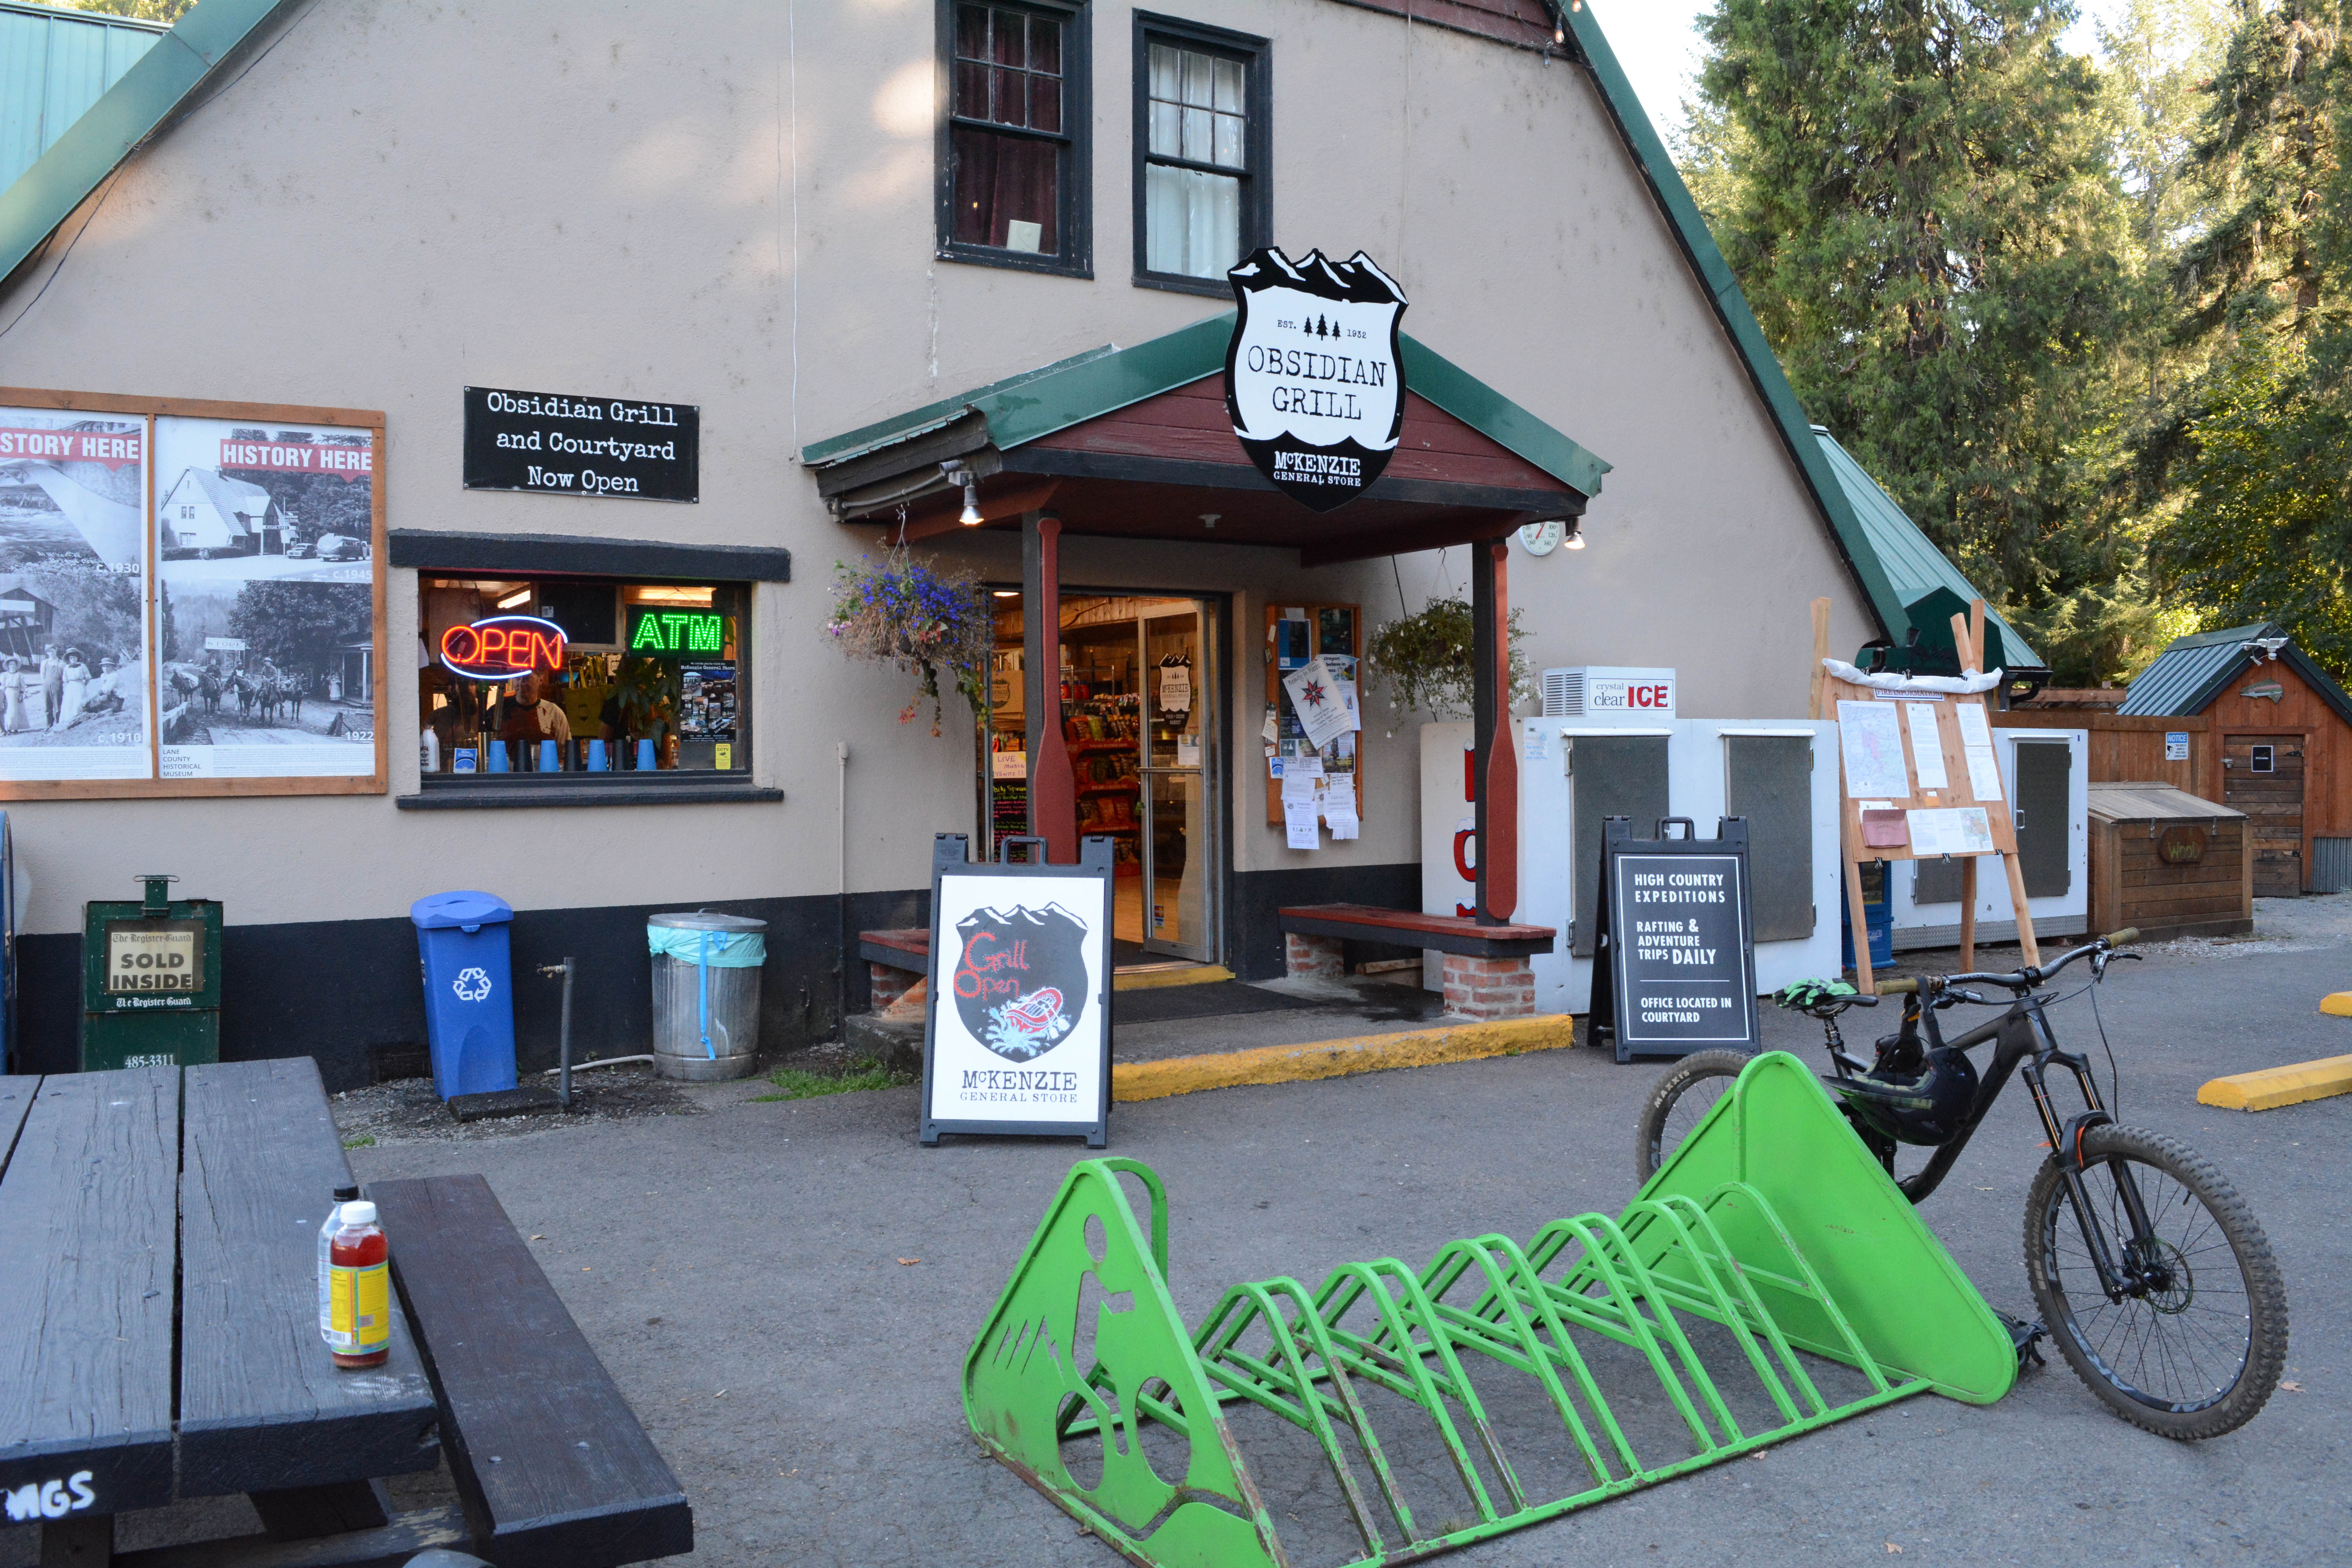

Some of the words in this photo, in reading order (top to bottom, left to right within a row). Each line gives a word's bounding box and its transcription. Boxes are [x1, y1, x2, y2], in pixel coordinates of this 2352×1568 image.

[1277, 319, 1296, 329] EST.
[1347, 329, 1367, 339] 1932
[1248, 345, 1387, 387] OBSIDIAN
[488, 392, 603, 420] Obsidian
[610, 403, 678, 426] Grill
[1272, 387, 1362, 420] GRILL
[82, 437, 139, 459] HERE
[497, 431, 542, 450] and
[550, 432, 675, 462] Courtyard
[223, 444, 313, 467] HISTORY
[320, 450, 372, 470] HERE
[528, 466, 575, 488] Now
[582, 470, 639, 494] Open
[1274, 472, 1325, 486] GENERAL
[1328, 476, 1361, 487] STORE
[96, 563, 140, 573] c.1930
[333, 570, 372, 579] c.1945
[633, 614, 721, 650] ATM
[441, 625, 561, 669] OPEN
[1288, 672, 1304, 685] Beauty
[1596, 683, 1624, 691] crystal
[1628, 682, 1668, 707] ICE
[1594, 692, 1625, 706] clear
[98, 733, 142, 743] c.1910
[345, 731, 374, 741] 1922
[1635, 874, 1664, 886] HIGH
[1669, 874, 1724, 886] COUNTRY
[1635, 891, 1725, 903] EXPEDITIONS
[1637, 922, 1683, 933] RAFTING
[1688, 918, 1699, 933] &
[113, 933, 129, 942] The
[1638, 936, 1700, 947] ADVENTURE
[964, 931, 1030, 971] Grill
[1639, 949, 1668, 960] TRIPS
[1672, 949, 1716, 964] DAILY
[121, 953, 184, 969] SOLD
[113, 973, 192, 989] INSIDE
[953, 969, 1019, 1001] Open
[1641, 998, 1673, 1008] OFFICE
[1676, 998, 1718, 1008] LOCATED
[1721, 998, 1732, 1008] IN
[1642, 1012, 1700, 1022] COURTYARD
[125, 1054, 174, 1069] 485-3311
[960, 1092, 1027, 1102] GENERAL
[1033, 1093, 1077, 1103] STORE
